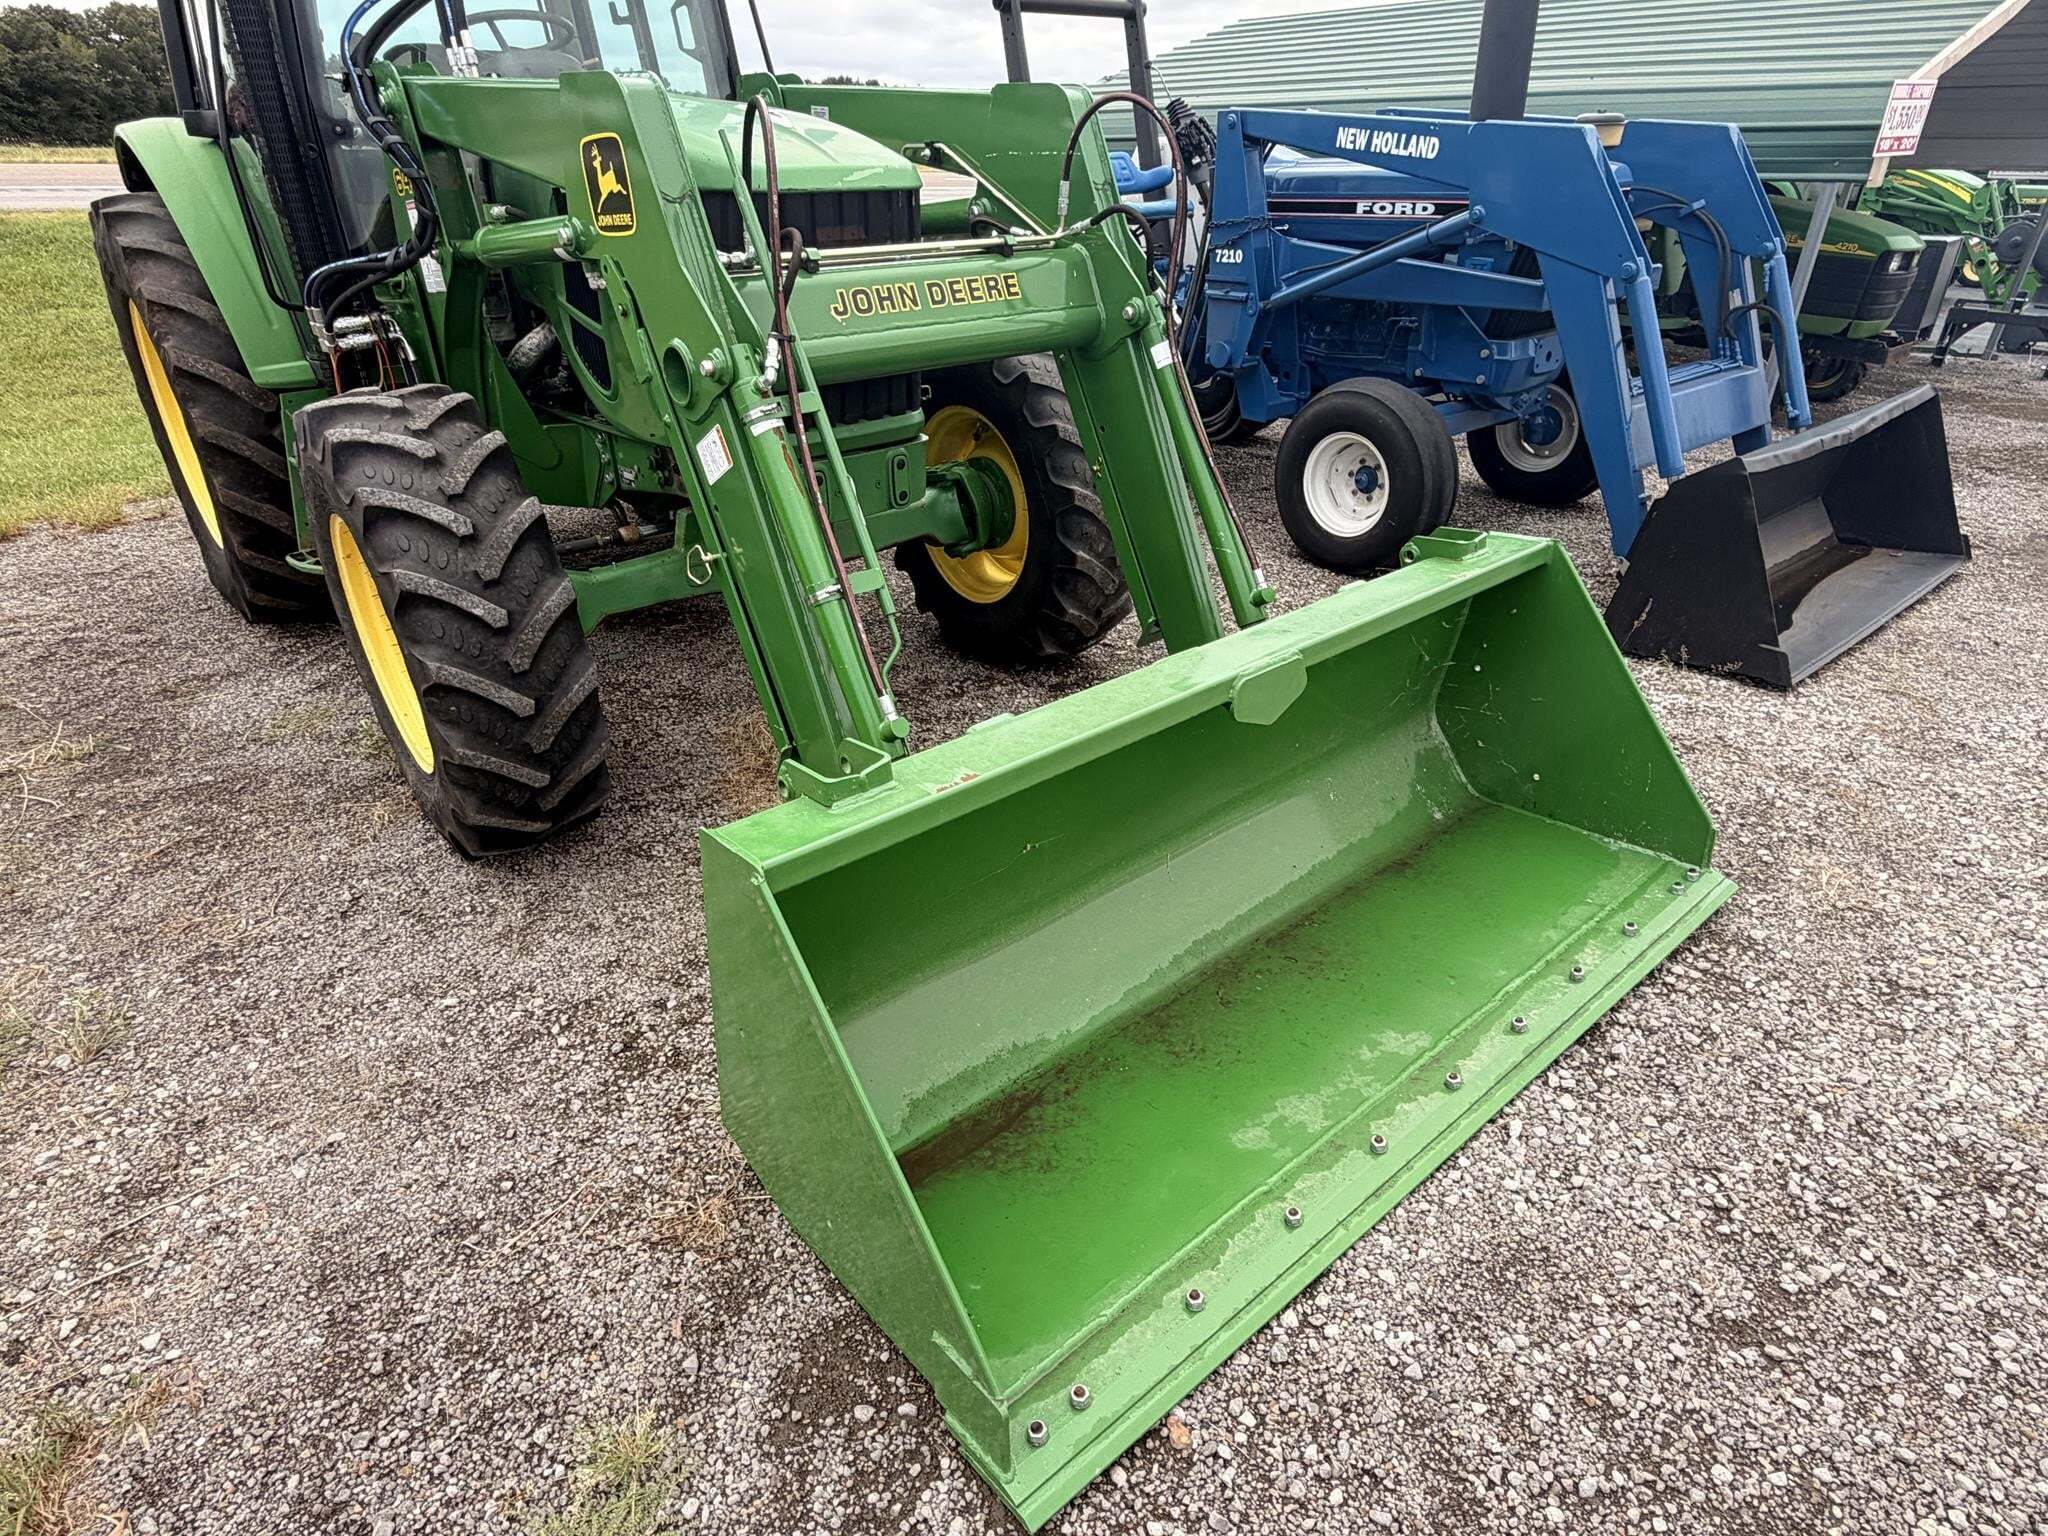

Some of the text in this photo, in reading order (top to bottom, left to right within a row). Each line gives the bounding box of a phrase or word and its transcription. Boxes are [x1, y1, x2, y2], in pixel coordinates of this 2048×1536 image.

[1336, 127, 1440, 160] NEW HOLLAND
[1356, 202, 1436, 215] FORD
[598, 213, 633, 226] JOHN DEERE
[1215, 249, 1243, 263] 7210
[830, 272, 1022, 319] JOHN DEERE
